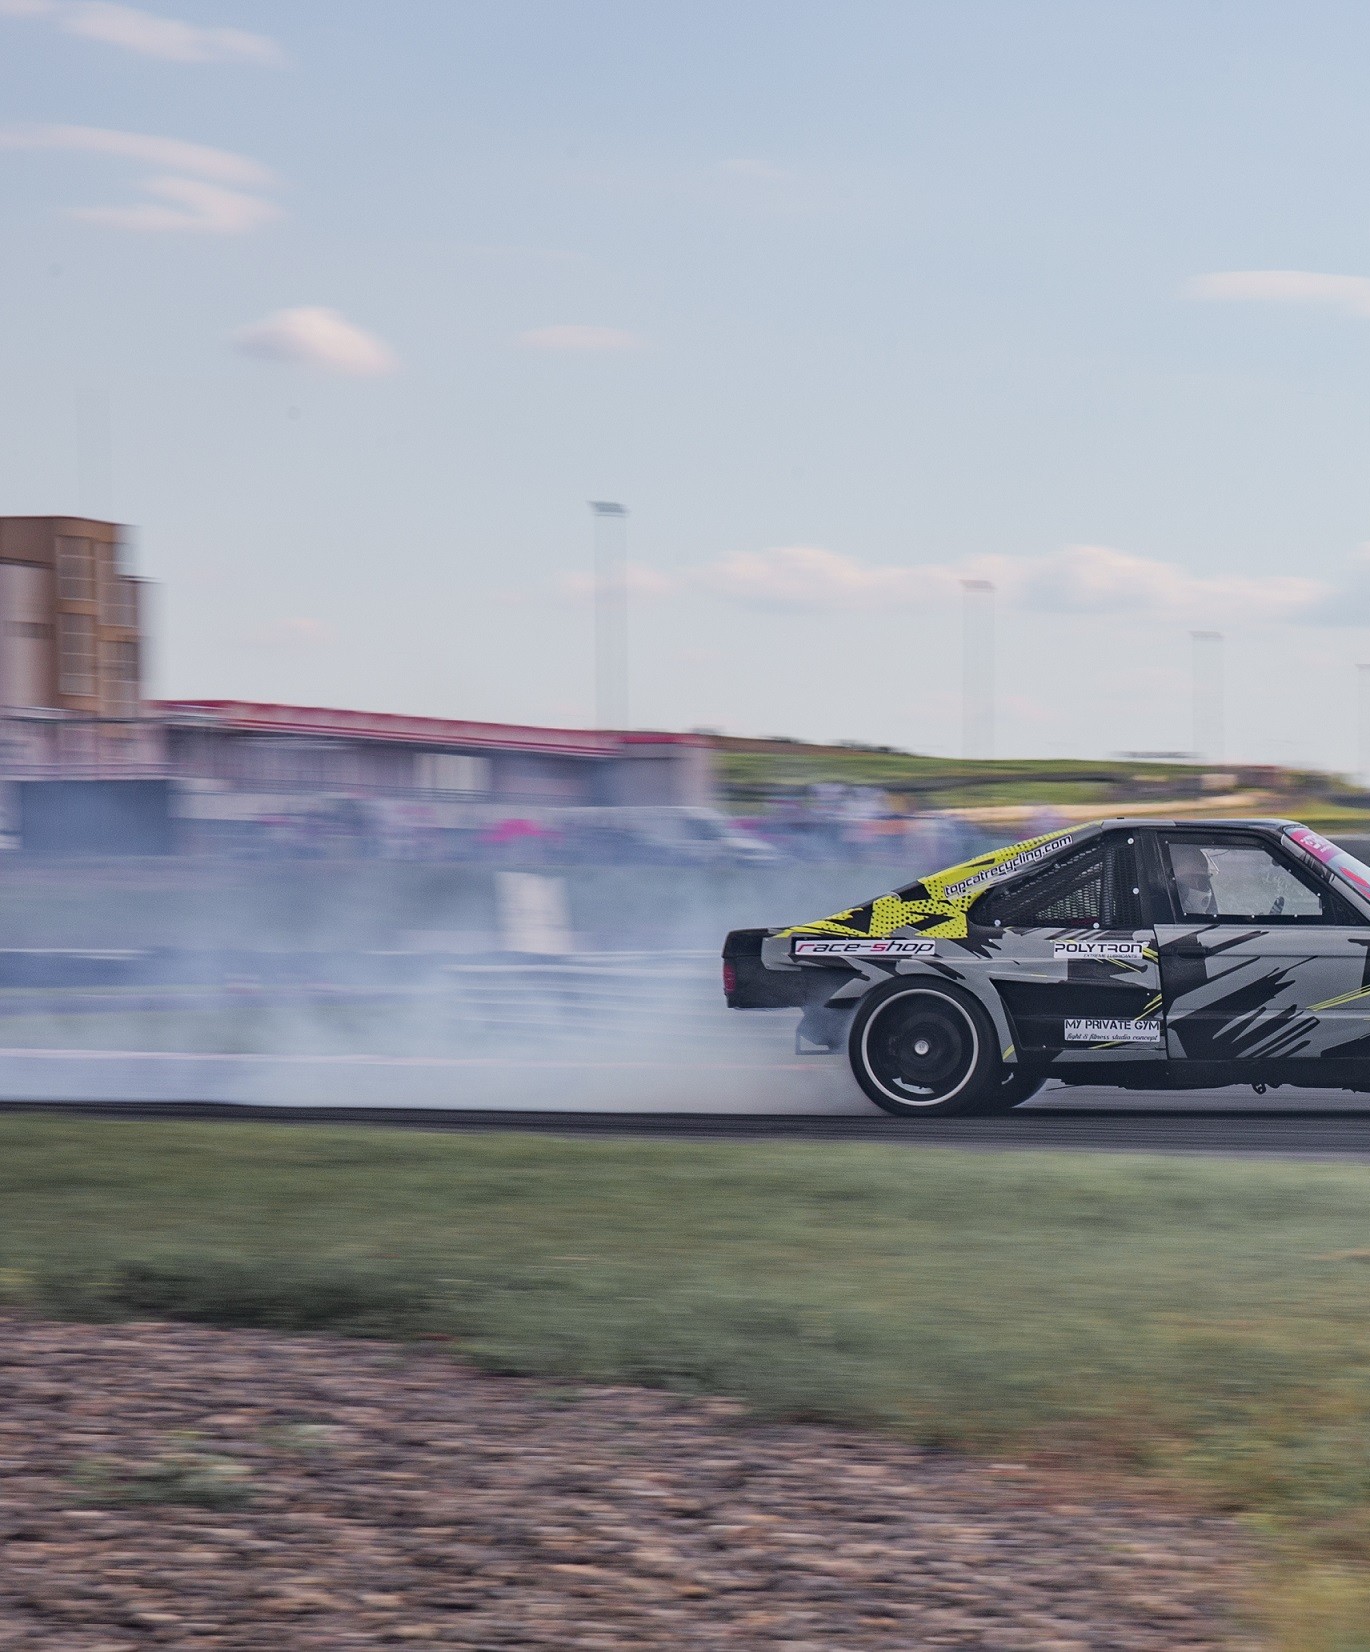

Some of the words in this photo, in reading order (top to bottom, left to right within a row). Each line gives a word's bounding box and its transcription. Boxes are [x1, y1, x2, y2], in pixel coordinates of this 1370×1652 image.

[944, 835, 1072, 897] topcatrecycling.com
[797, 941, 934, 954] race-shop
[1055, 943, 1142, 953] POLYTRON
[1065, 1020, 1081, 1029] MY
[1085, 1020, 1131, 1030] PRIVATE
[1134, 1020, 1159, 1030] GYM
